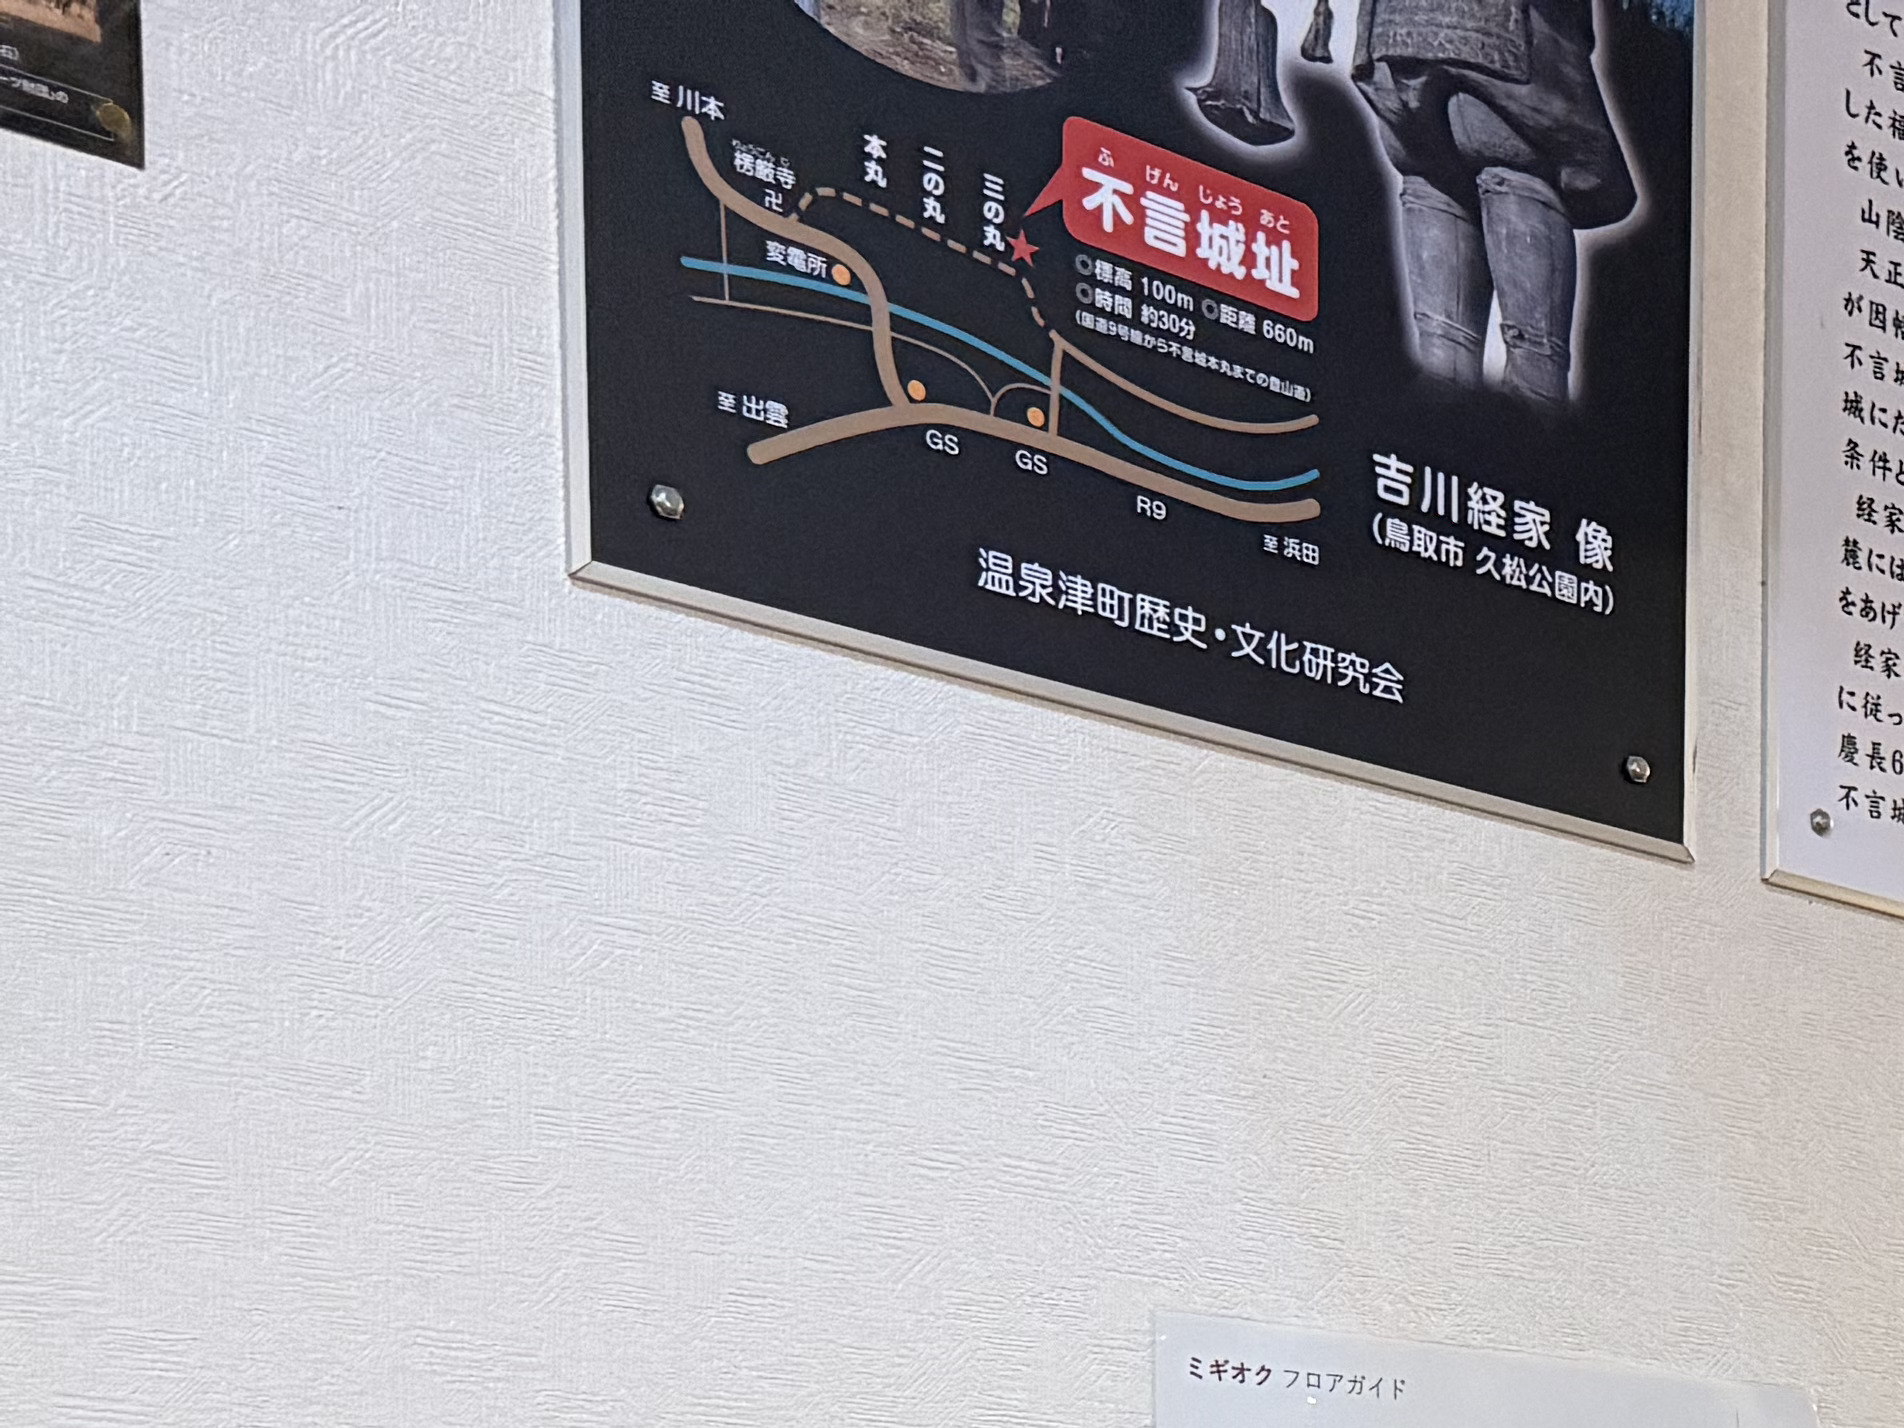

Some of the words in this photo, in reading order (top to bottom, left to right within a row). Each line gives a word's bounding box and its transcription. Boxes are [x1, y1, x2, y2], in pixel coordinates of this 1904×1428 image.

[650, 80, 672, 104] 至
[676, 84, 725, 121] 川本
[862, 133, 888, 189] 本丸
[921, 145, 946, 224] 二の丸
[982, 172, 1006, 252] 三の丸
[1097, 146, 1115, 169] ふ
[1145, 164, 1180, 192] げん
[1198, 184, 1244, 216] じょう
[1259, 208, 1291, 235] あと
[764, 239, 828, 279] 変電所
[1081, 166, 1301, 300] 不言城址
[1094, 258, 1134, 292] 標高
[1140, 276, 1194, 313] 100m
[1218, 303, 1257, 336] 距離
[1262, 319, 1315, 355] 660m
[1094, 287, 1134, 320] 時間
[1140, 302, 1196, 341] 約30分
[742, 394, 790, 430] 出雲
[924, 428, 960, 457] GS
[1014, 448, 1049, 476] GS
[1136, 494, 1168, 521] R9
[1372, 452, 1552, 551] 吉川経家
[1574, 517, 1614, 573] 像
[1283, 535, 1321, 567] 浜田
[1371, 511, 1465, 569] (鳥取市
[1475, 544, 1615, 616] 久松公園内)
[976, 546, 1406, 705] 温泉津町歴史・文化研究会
[1188, 1356, 1273, 1387] ミギオク
[1282, 1368, 1407, 1402] フロアガイド
